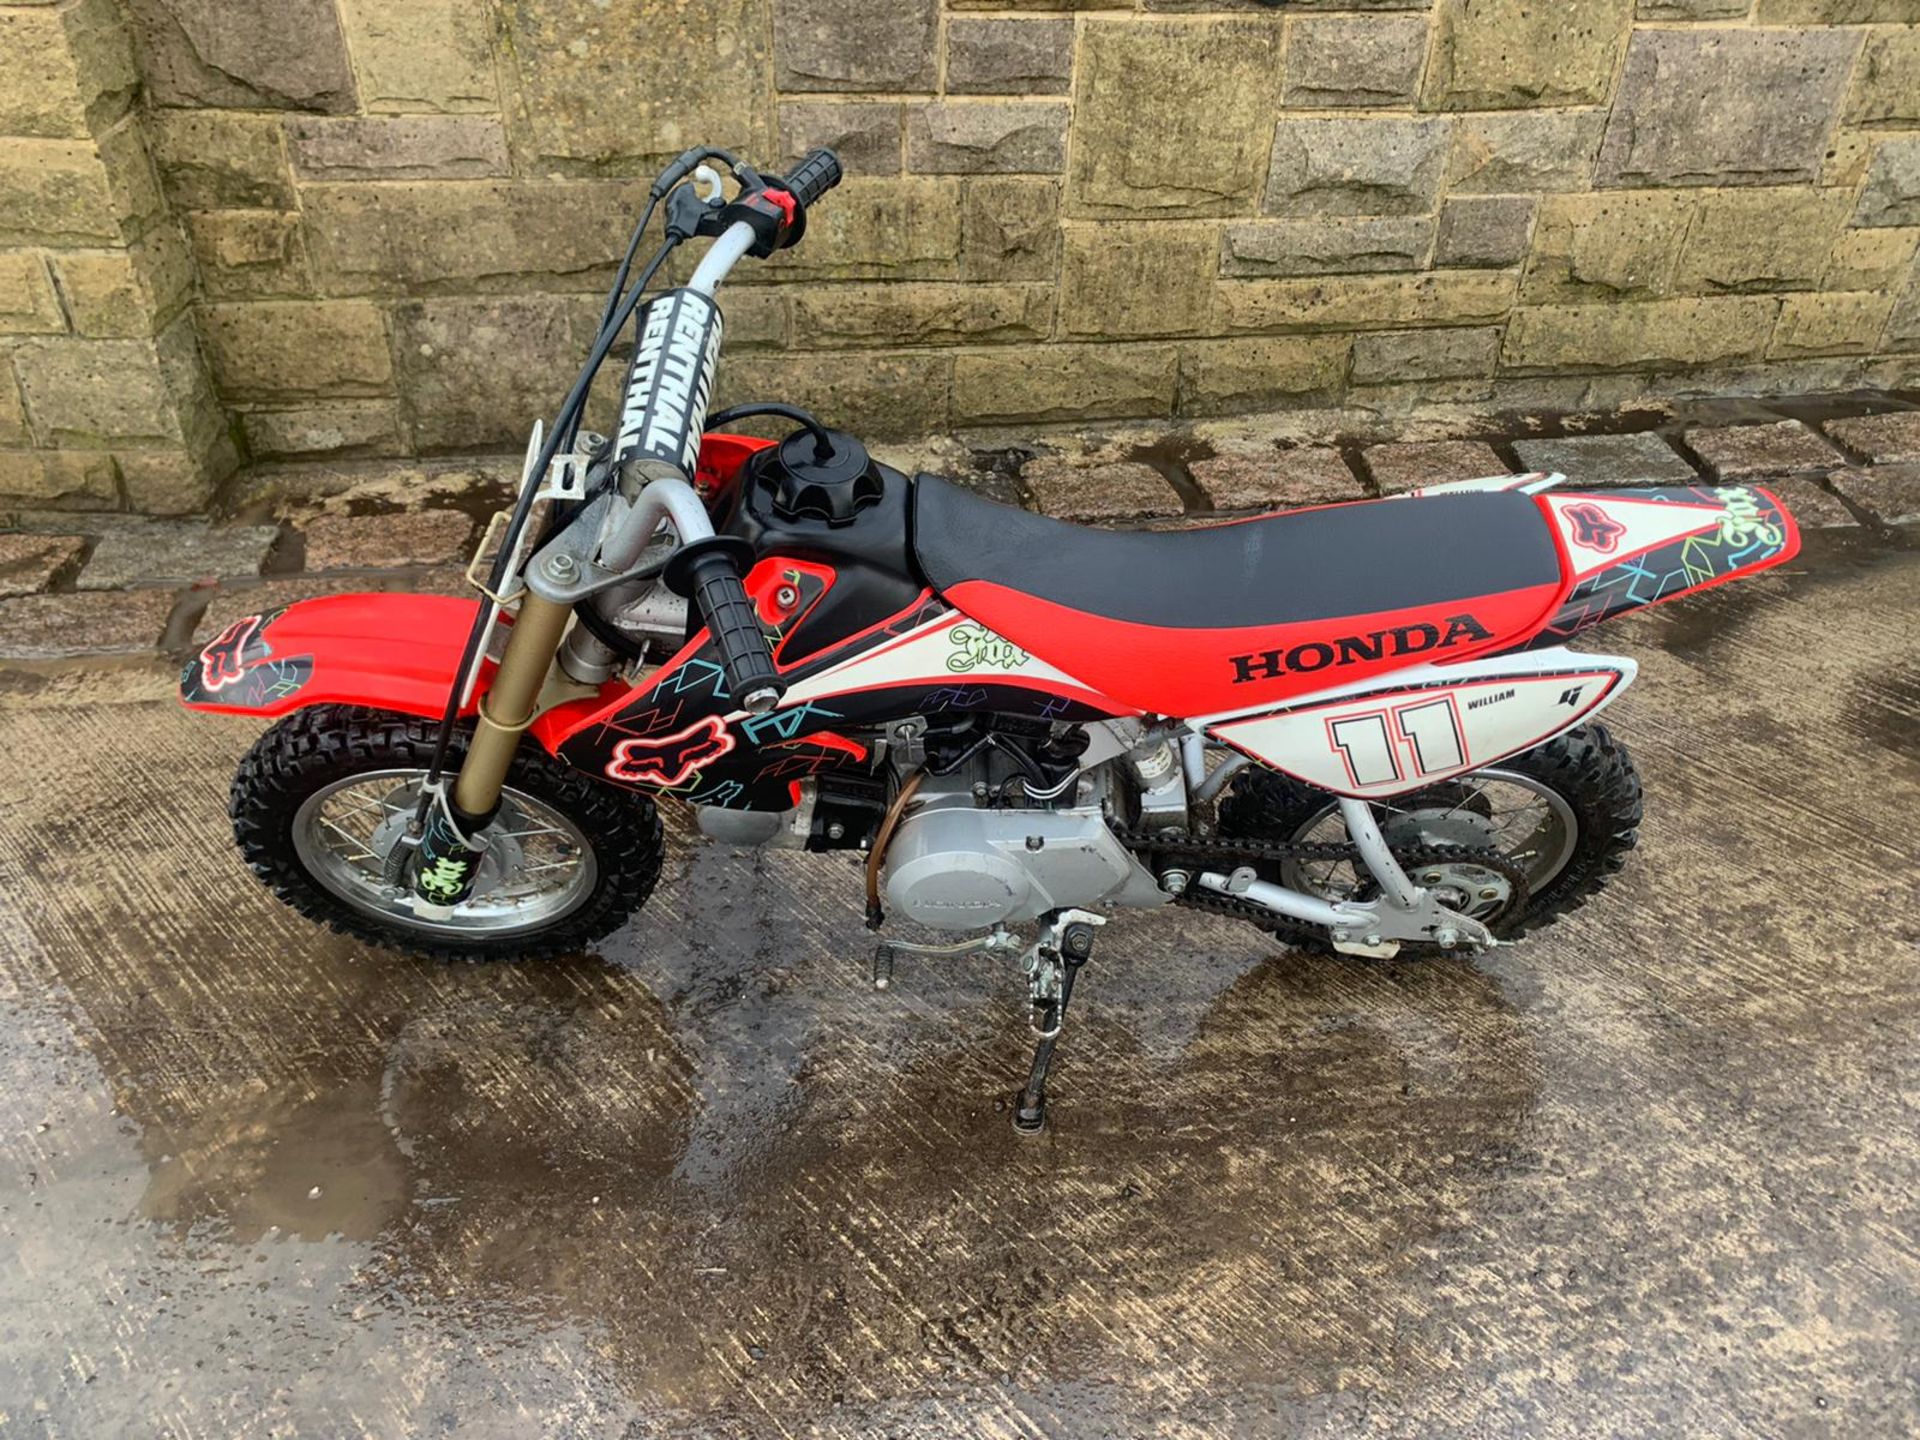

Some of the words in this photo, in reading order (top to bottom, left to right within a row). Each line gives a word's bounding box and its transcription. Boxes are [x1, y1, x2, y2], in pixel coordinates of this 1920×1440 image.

[613, 296, 677, 462] RENTHAL
[644, 291, 711, 453] RENTHAL
[1229, 614, 1494, 684] HONDA
[1325, 693, 1470, 789] 11
[1467, 688, 1515, 710] WILLIAM
